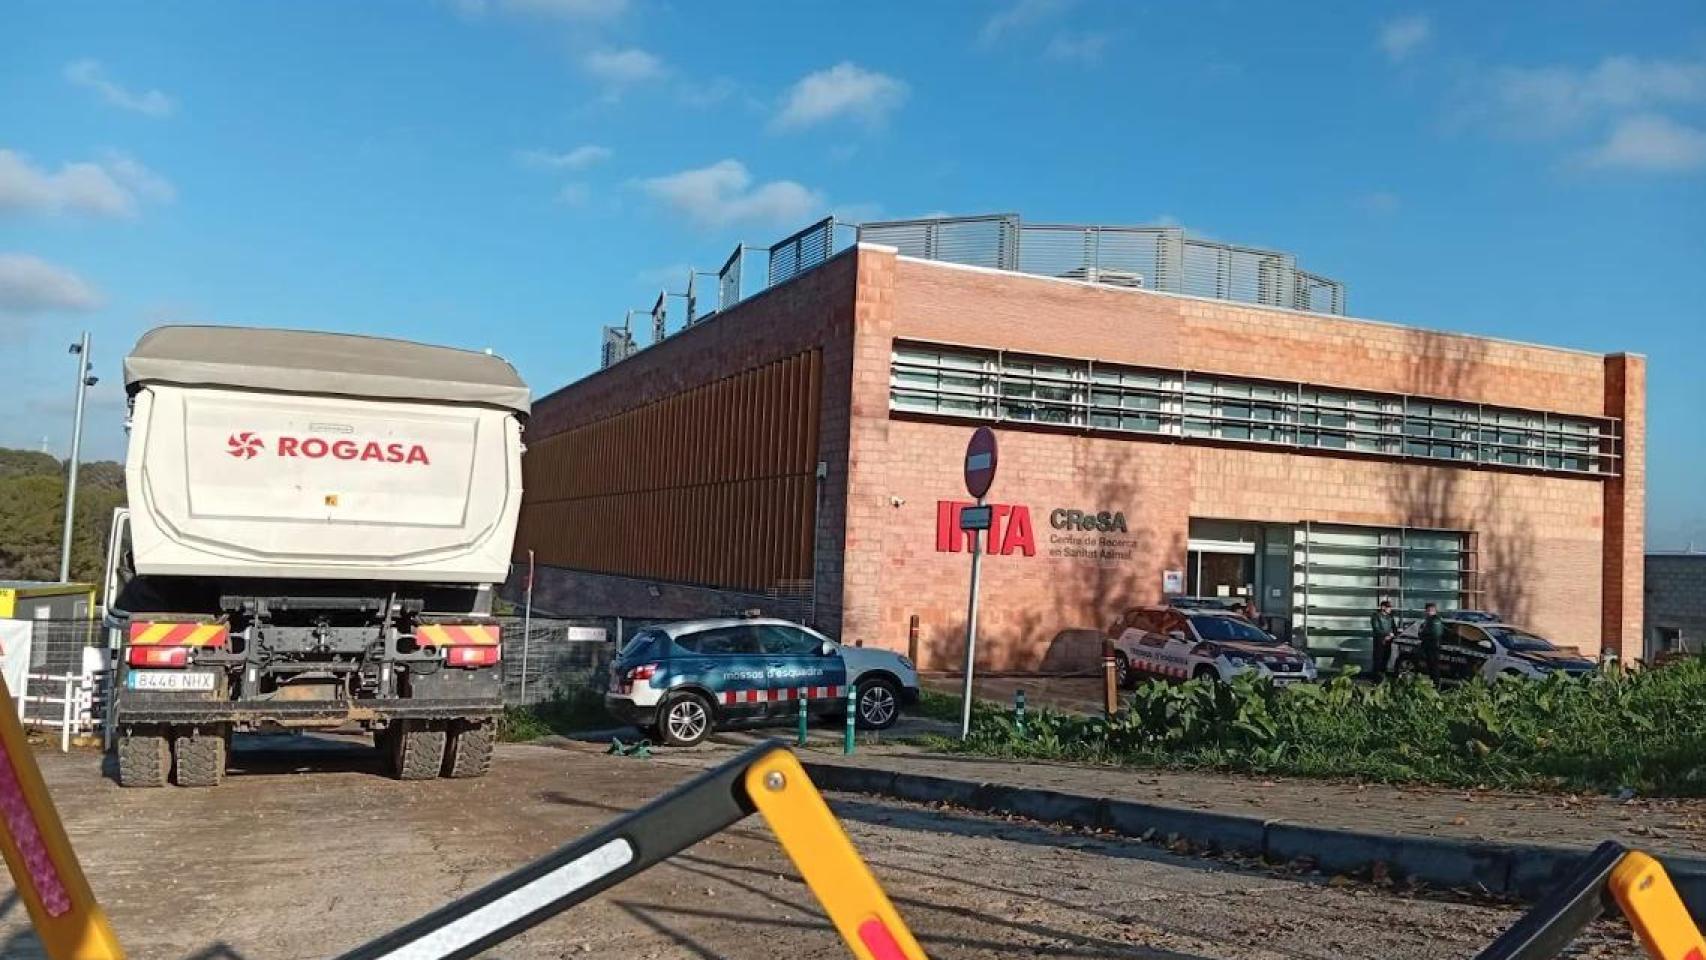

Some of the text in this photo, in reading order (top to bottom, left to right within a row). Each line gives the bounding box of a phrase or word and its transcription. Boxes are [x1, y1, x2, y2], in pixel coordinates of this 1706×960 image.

[278, 437, 430, 465] ROGASA
[1050, 508, 1128, 533] CReSA
[1050, 534, 1082, 545] Centre
[1084, 536, 1097, 546] de
[1049, 546, 1133, 560] en Sanitat Animal
[723, 667, 824, 680] mossos d'esquadra
[139, 674, 176, 687] 8446
